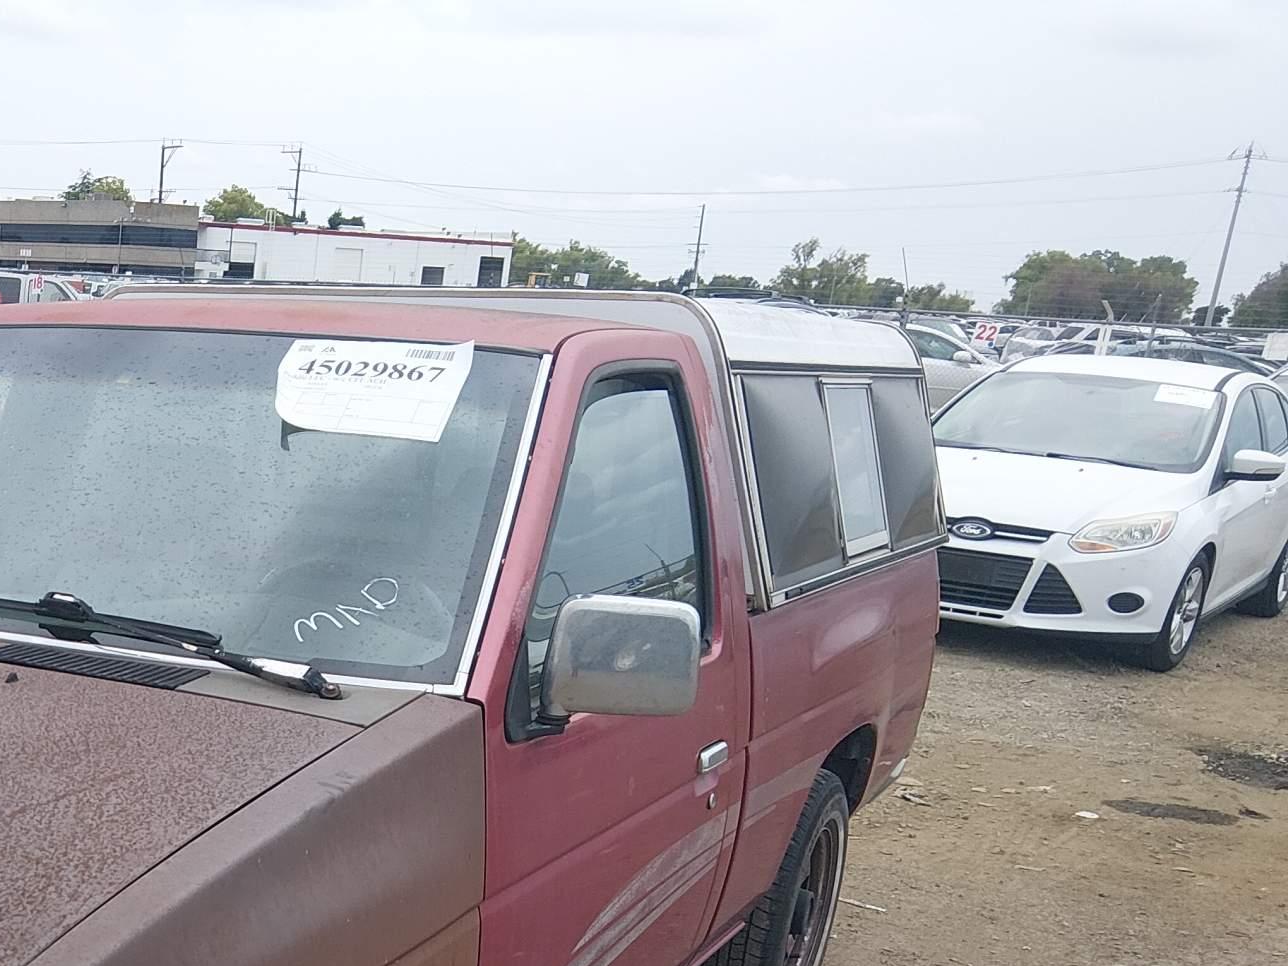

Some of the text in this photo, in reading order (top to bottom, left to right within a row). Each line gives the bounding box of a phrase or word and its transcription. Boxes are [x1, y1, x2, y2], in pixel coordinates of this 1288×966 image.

[33, 276, 43, 289] 18
[974, 324, 998, 341] 22
[298, 359, 445, 383] 45029867
